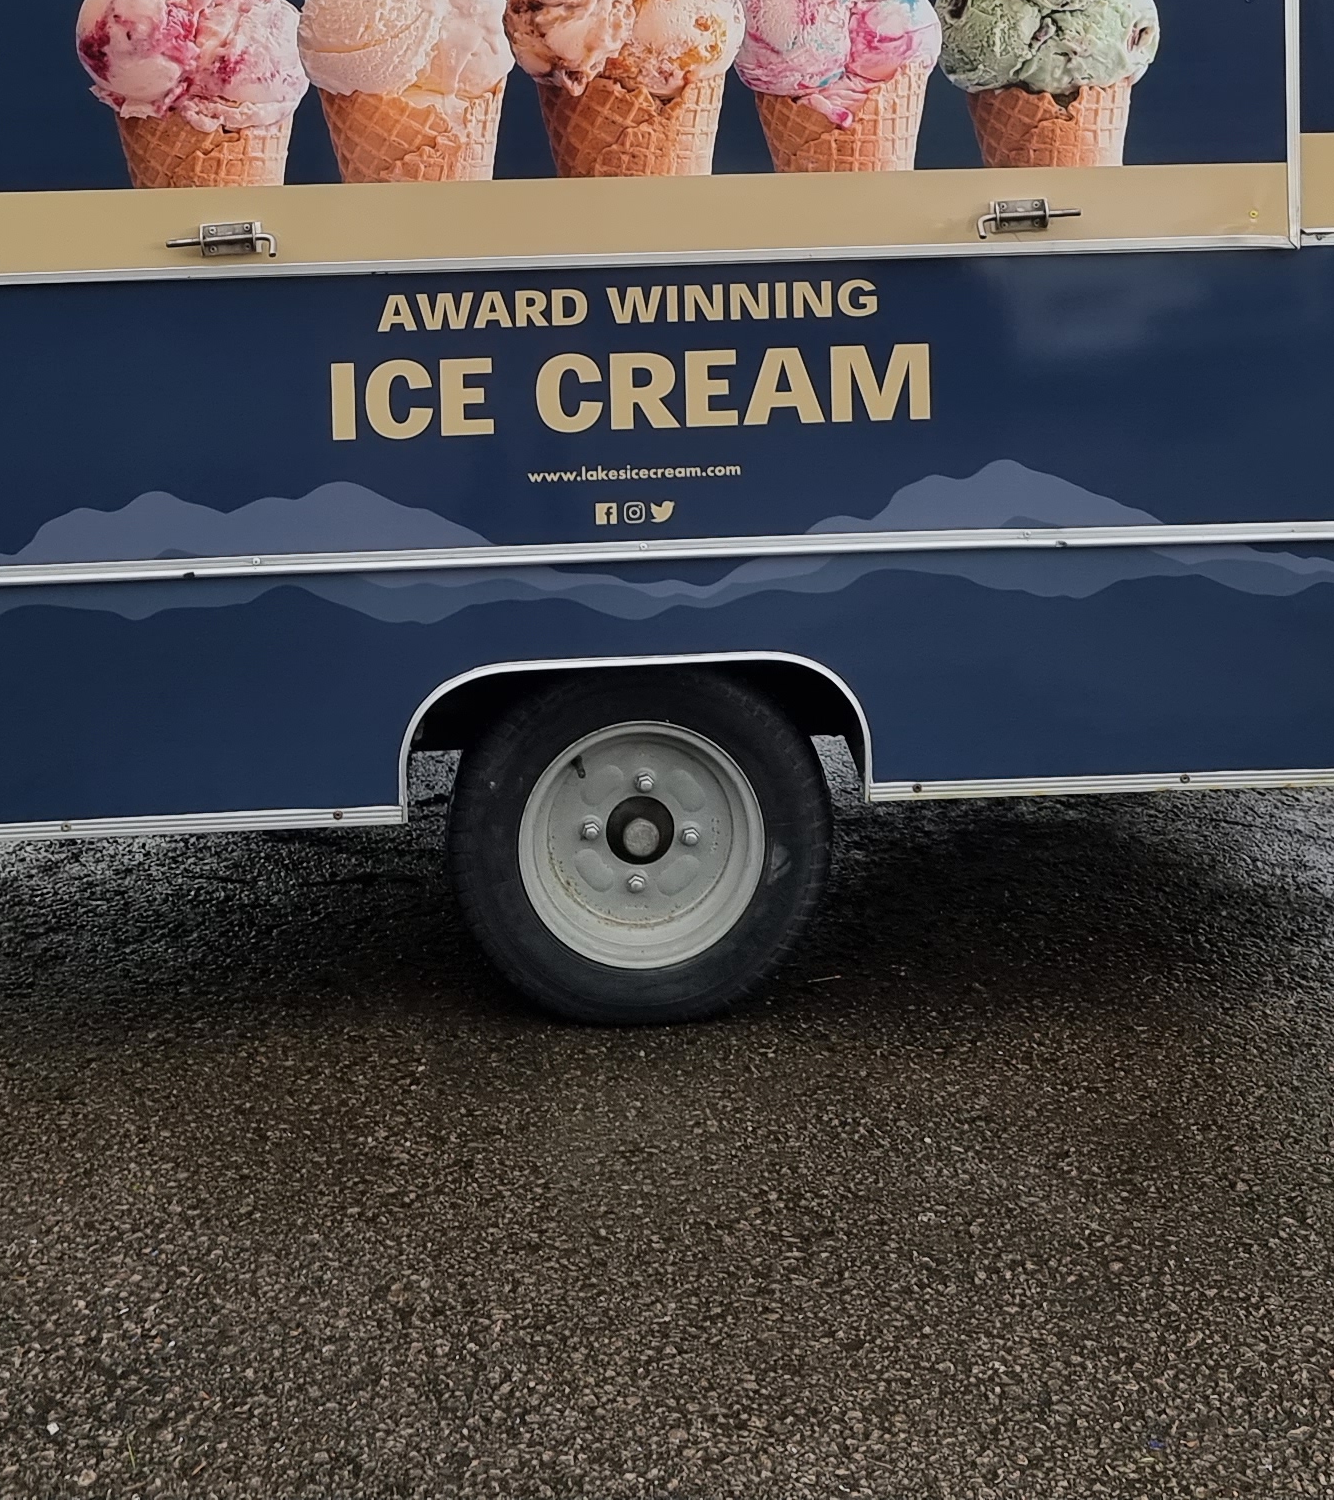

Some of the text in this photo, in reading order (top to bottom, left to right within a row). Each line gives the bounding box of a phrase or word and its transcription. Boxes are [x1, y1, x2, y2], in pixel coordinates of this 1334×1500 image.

[377, 279, 878, 332] AWARD WINNING
[330, 343, 932, 441] ICE CREAM
[528, 464, 741, 483] www.lakesicecream.com
